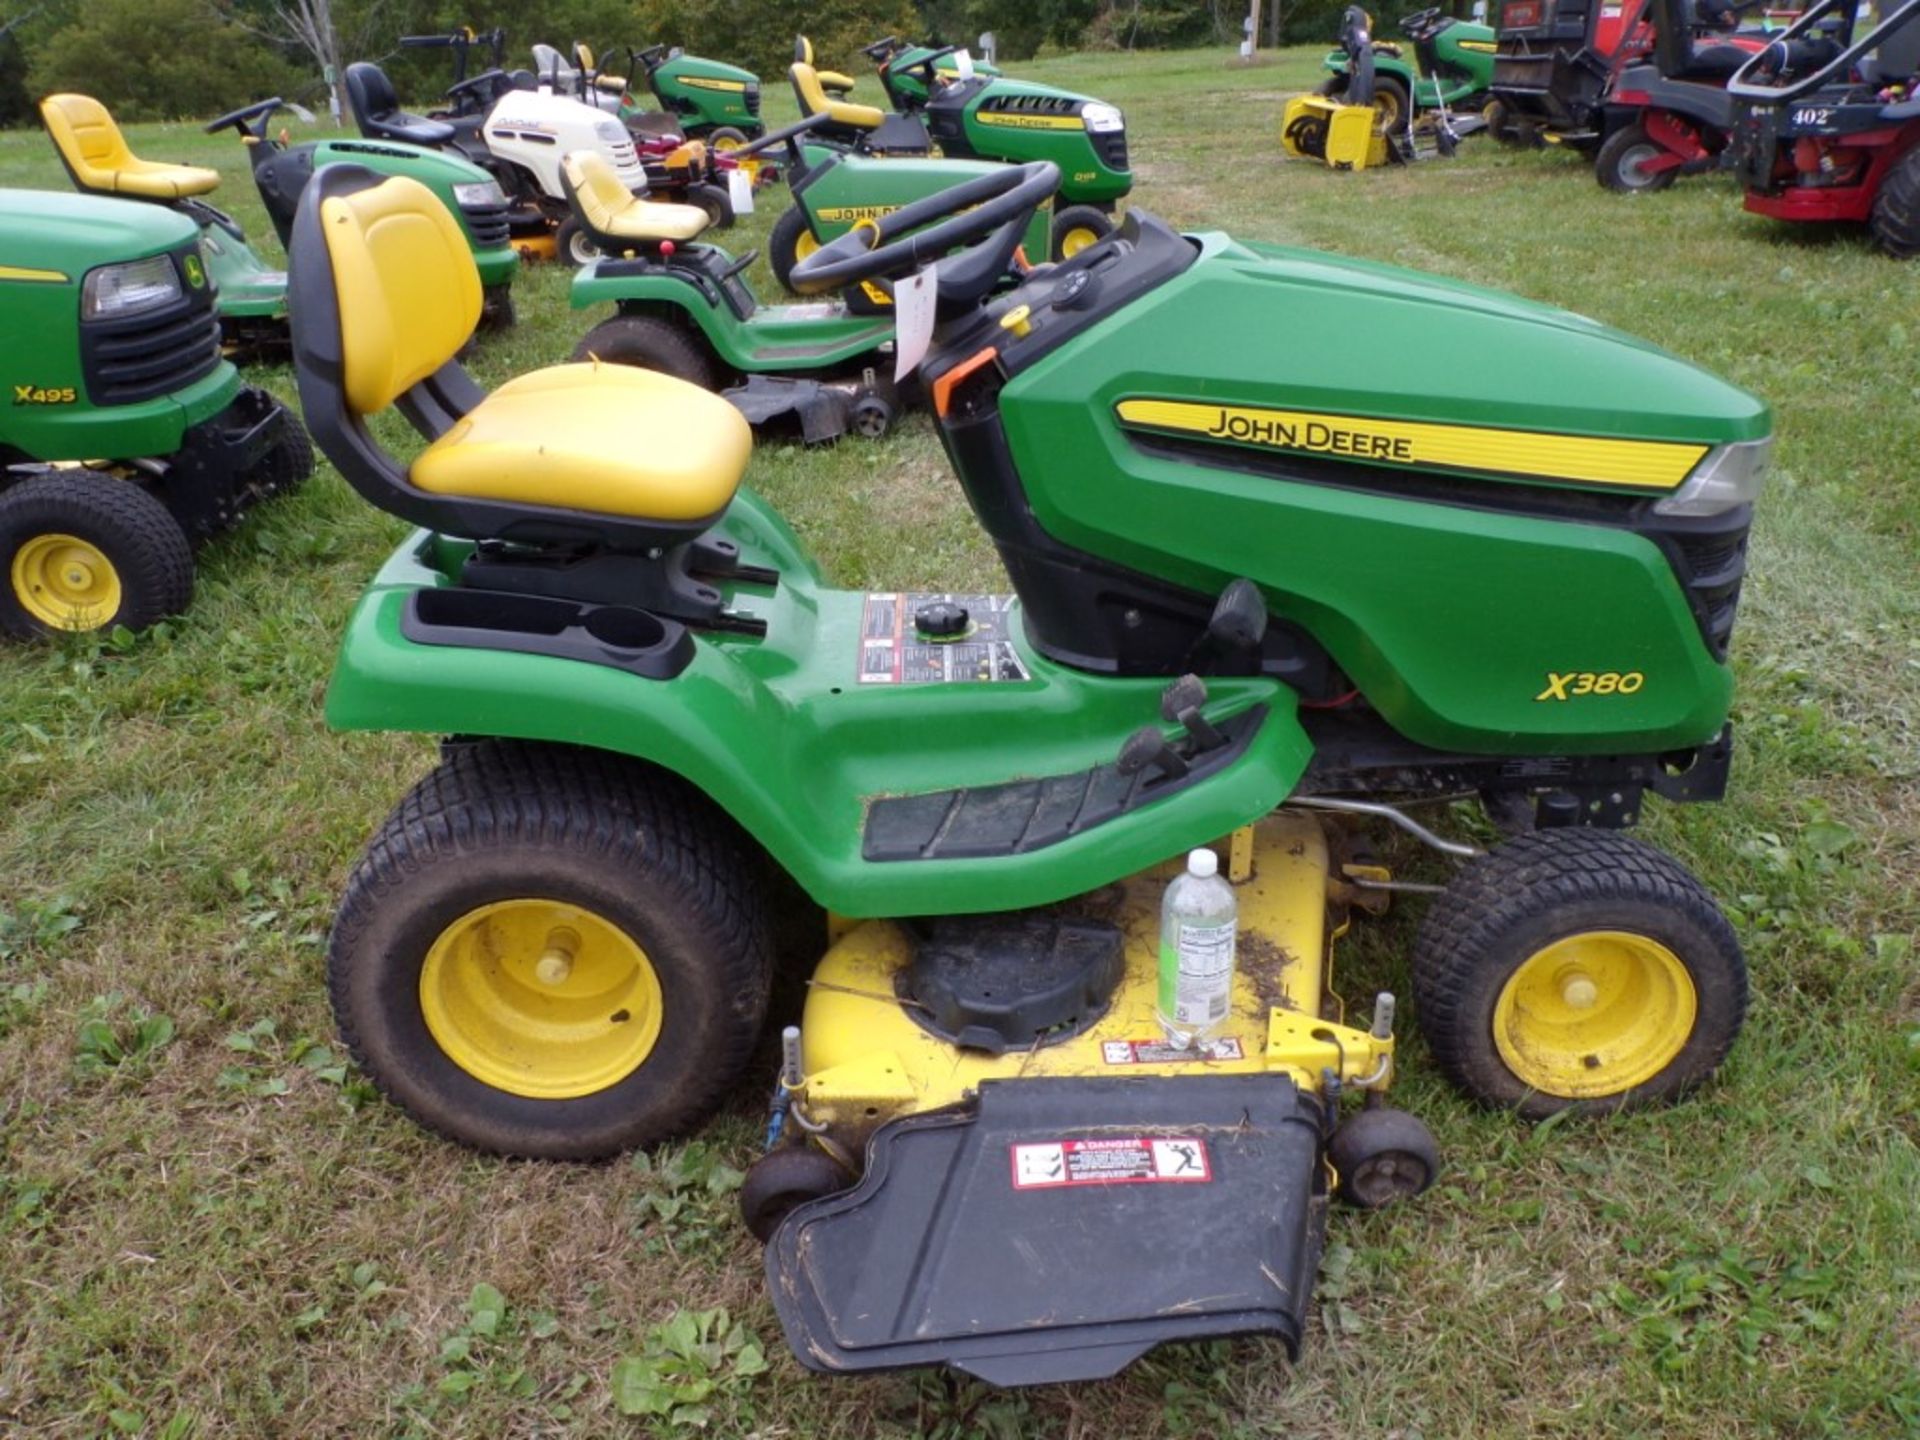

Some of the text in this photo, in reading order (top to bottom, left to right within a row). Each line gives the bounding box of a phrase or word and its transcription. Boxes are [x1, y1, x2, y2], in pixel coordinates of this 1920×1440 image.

[1792, 108, 1828, 125] 402
[834, 207, 877, 220] JOHN
[13, 385, 77, 403] X495
[1208, 409, 1413, 459] JOHN DEERE
[1535, 671, 1644, 701] X380
[1087, 1140, 1141, 1150] DANGER
